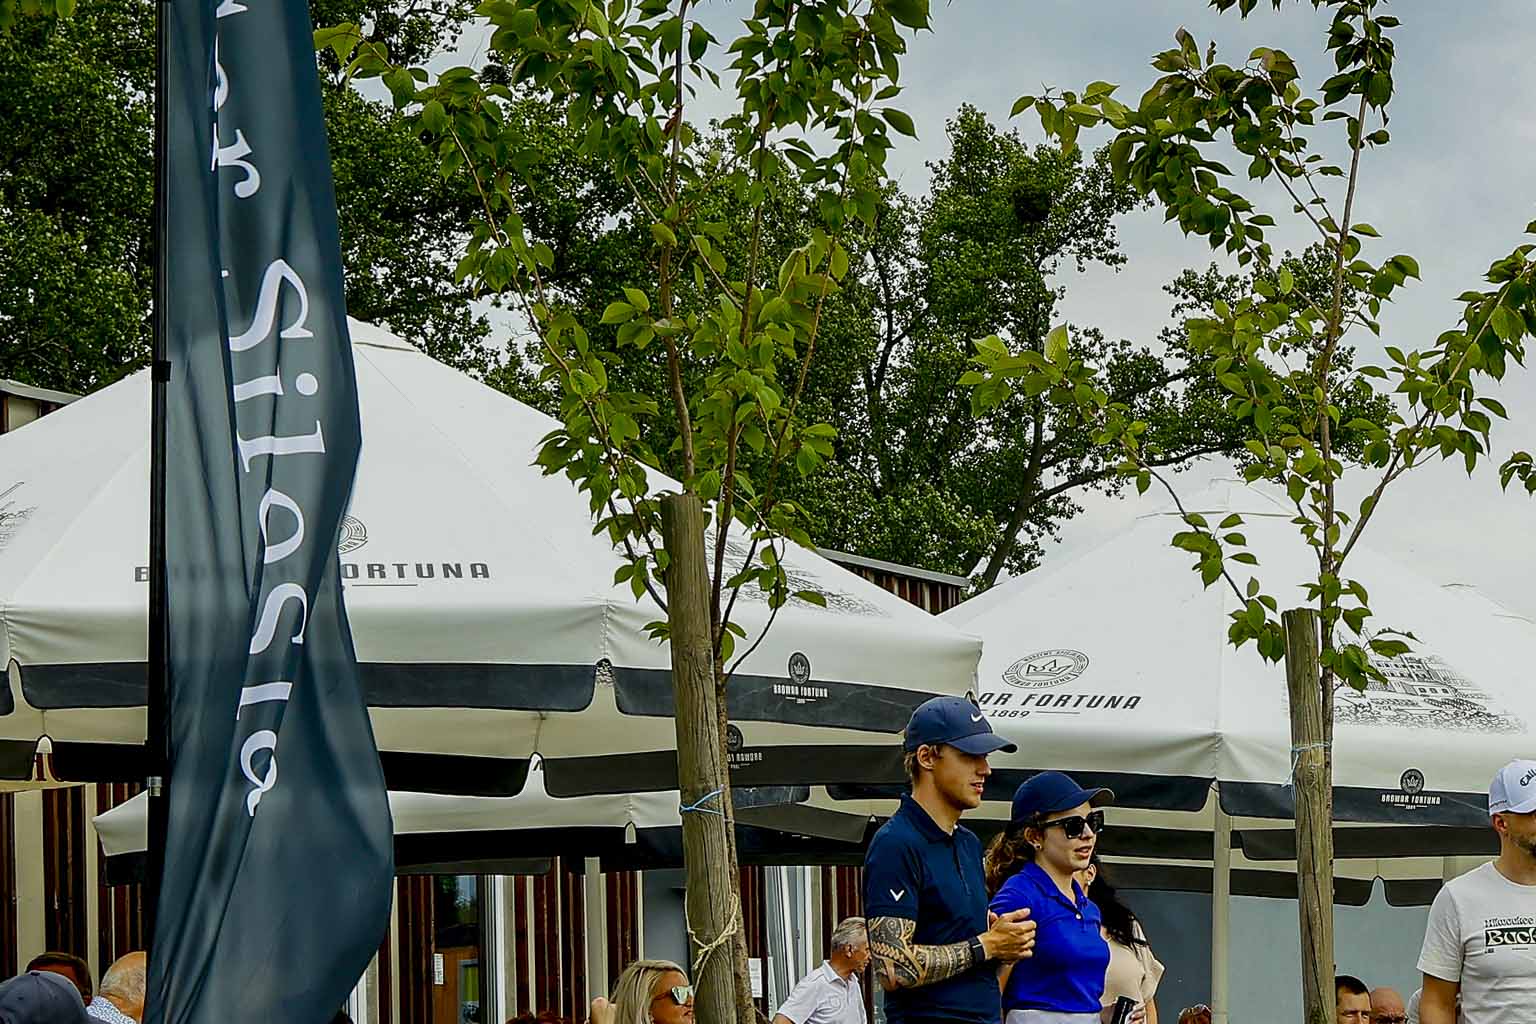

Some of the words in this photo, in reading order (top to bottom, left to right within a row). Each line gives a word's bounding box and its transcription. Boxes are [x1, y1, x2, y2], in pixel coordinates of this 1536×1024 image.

[341, 562, 490, 580] ORTUNA
[1021, 694, 1142, 710] FORTUNA
[1485, 916, 1535, 928] Milwaukee
